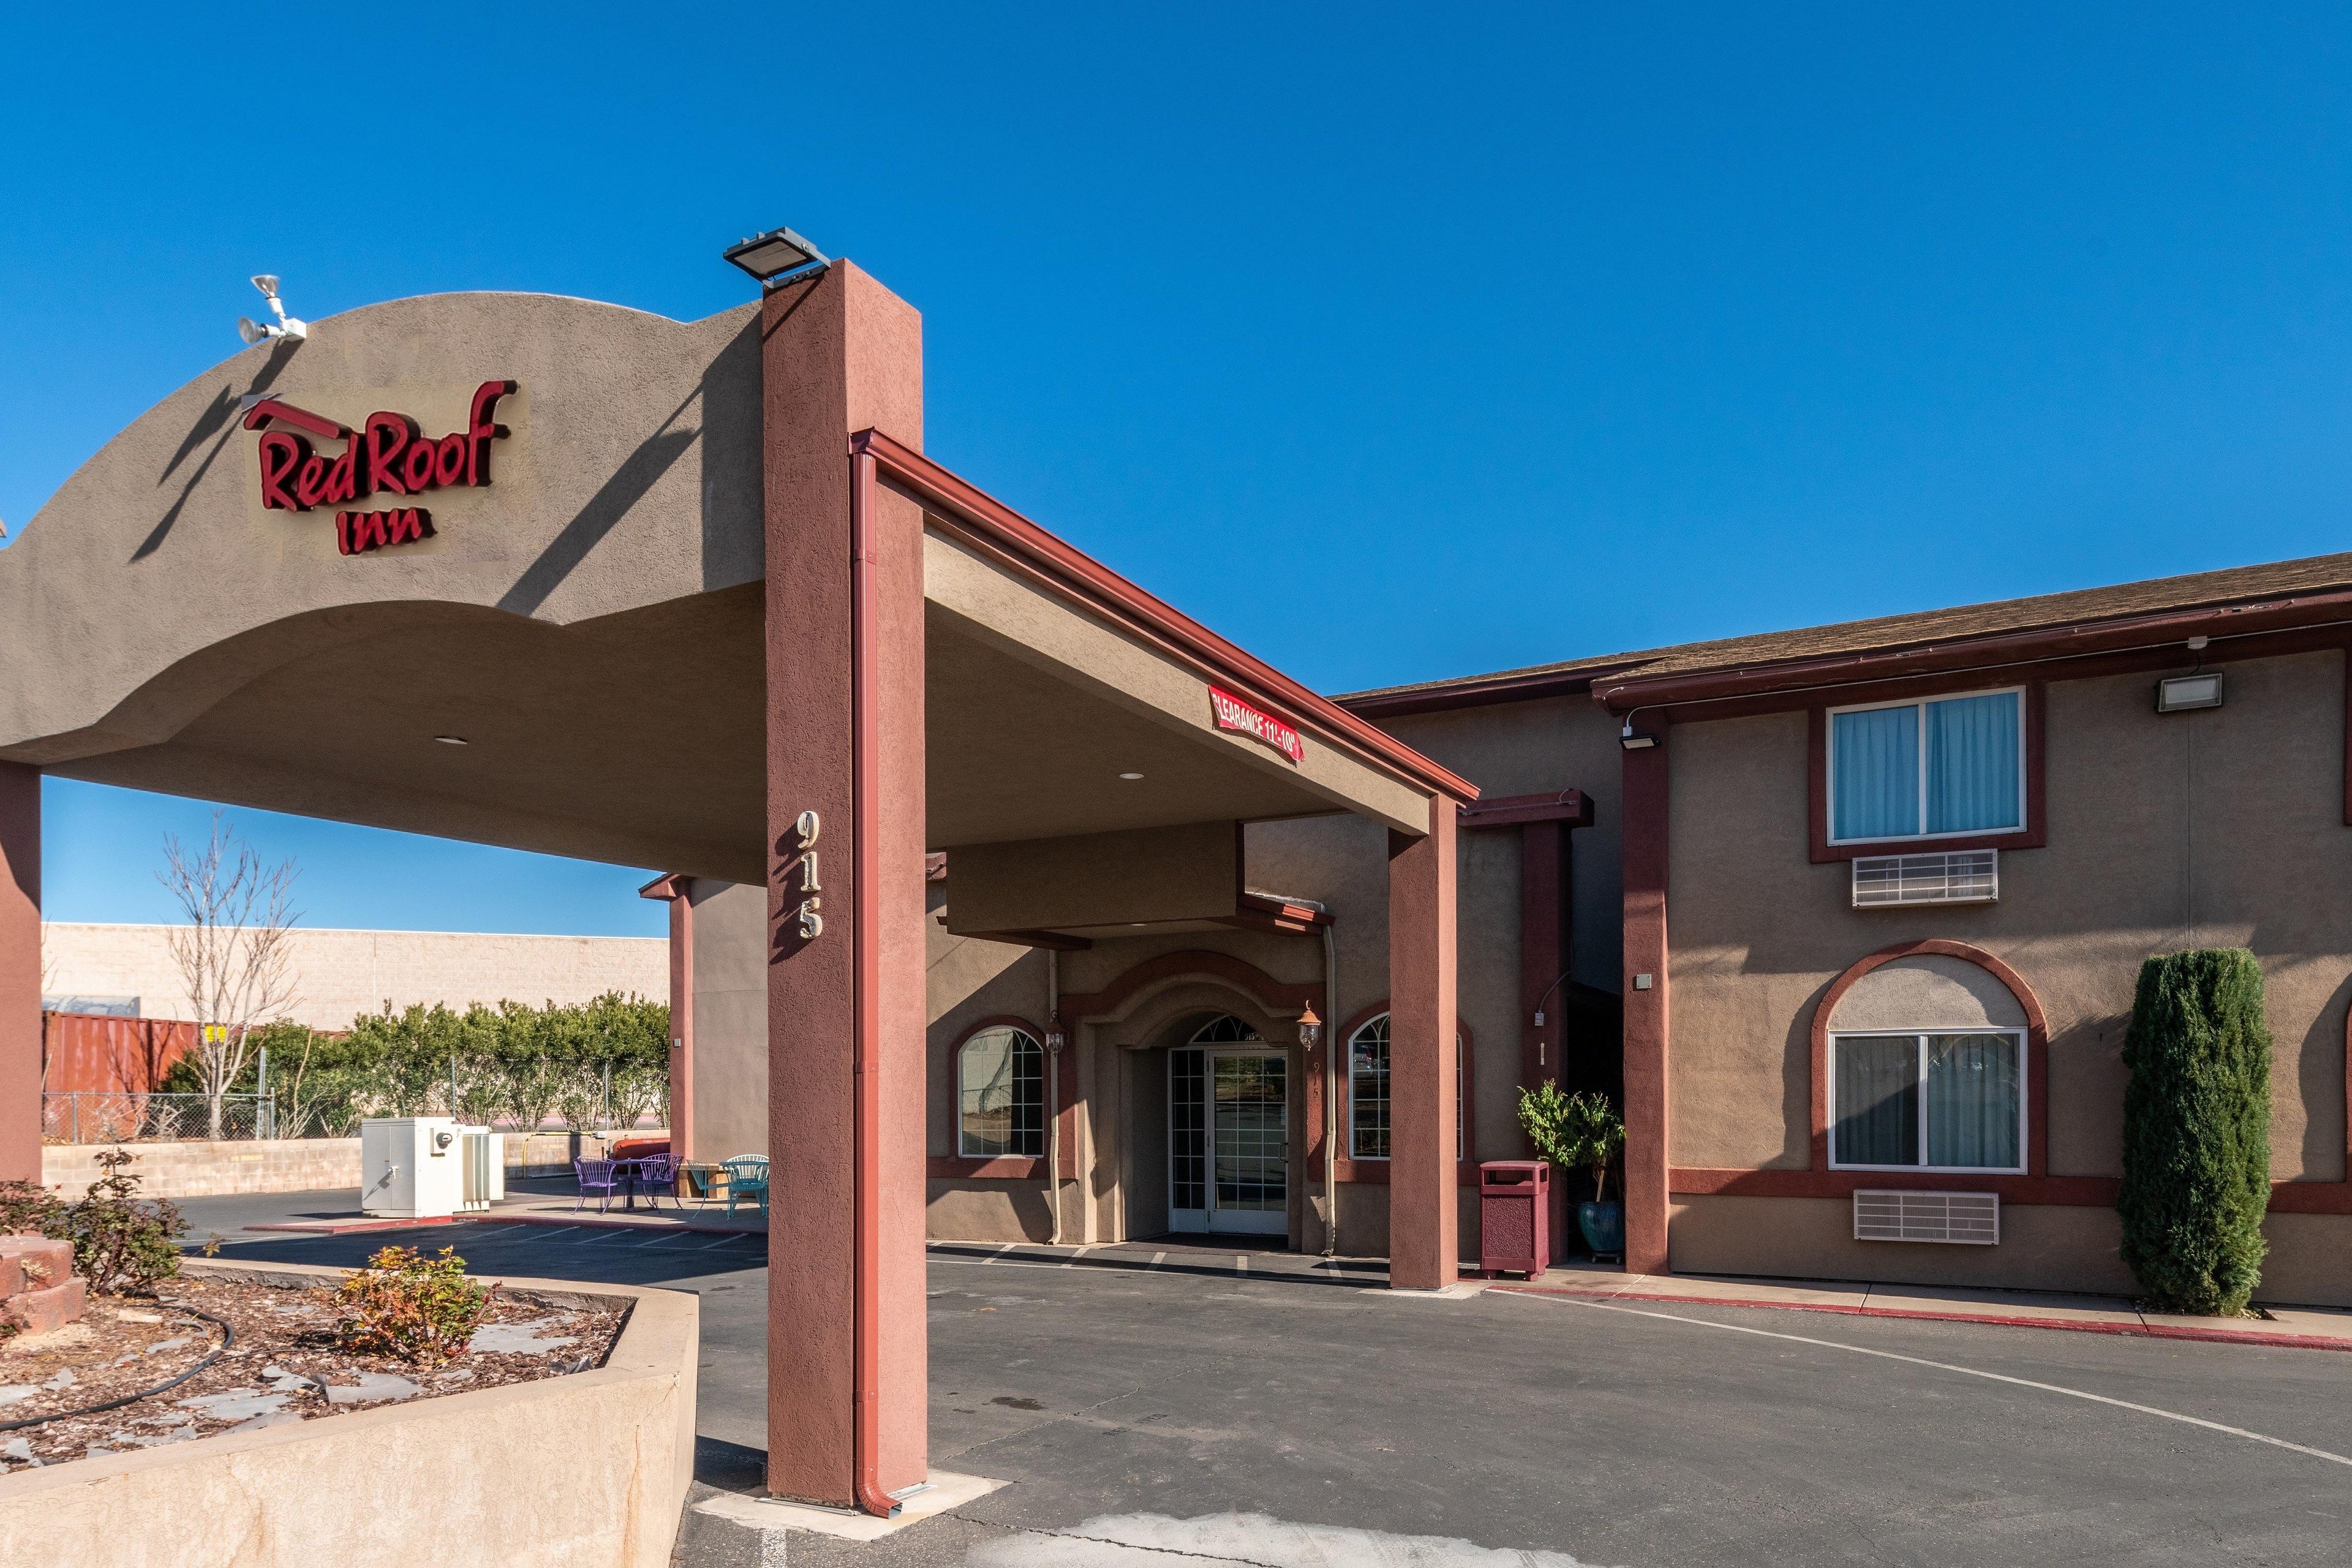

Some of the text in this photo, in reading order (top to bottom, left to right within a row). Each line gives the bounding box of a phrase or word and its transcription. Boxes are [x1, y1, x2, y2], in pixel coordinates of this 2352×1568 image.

[259, 380, 513, 511] Red Roof
[797, 810, 823, 939] 915
